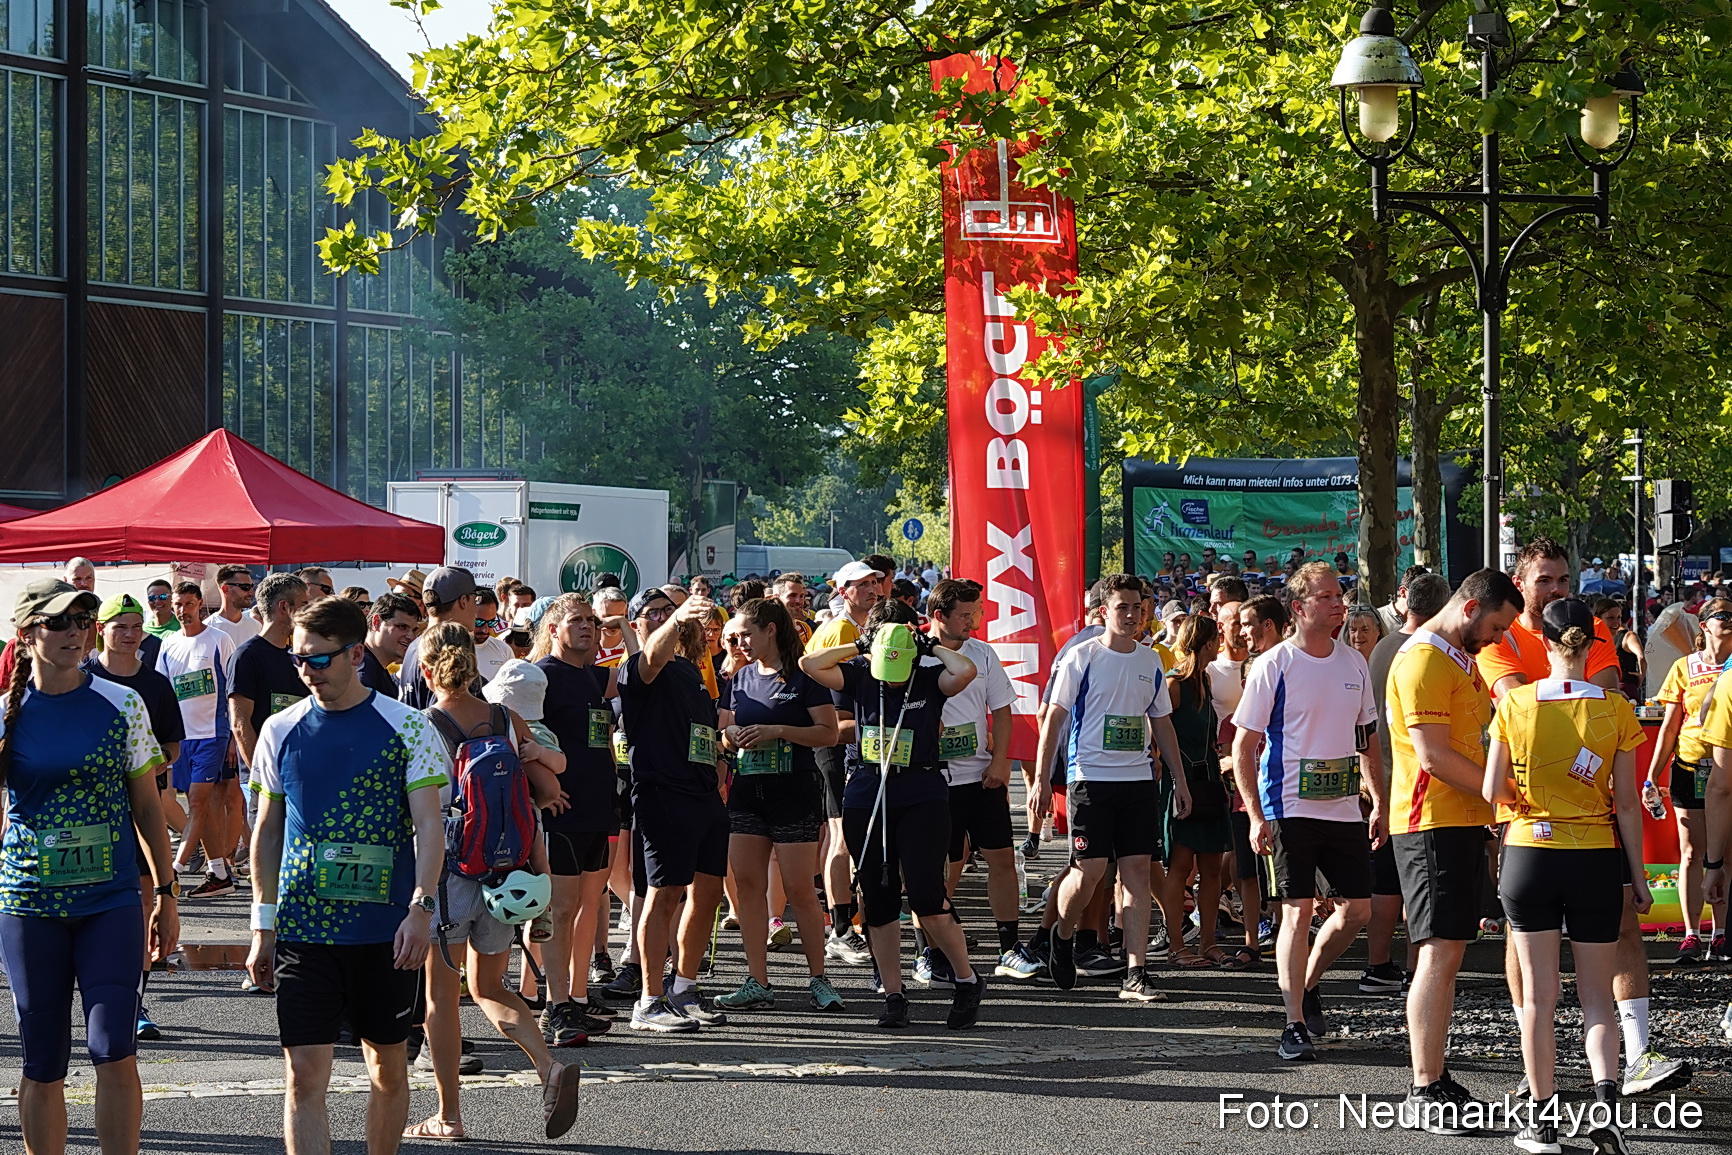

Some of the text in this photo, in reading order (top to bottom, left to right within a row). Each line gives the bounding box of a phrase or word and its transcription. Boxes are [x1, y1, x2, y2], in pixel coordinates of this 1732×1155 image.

[1183, 474, 1203, 486] Mich
[1205, 475, 1226, 487] kann
[1227, 479, 1247, 488] man
[1248, 476, 1281, 488] mieten!
[1282, 476, 1303, 488] Infos
[1305, 477, 1329, 487] unter
[1170, 522, 1235, 540] firmenlauf
[1262, 511, 1340, 539] Gesunde
[460, 526, 500, 543] Bögerl
[454, 559, 488, 569] Metzgerei
[571, 559, 629, 591] Böl
[987, 520, 1040, 716] MAX
[180, 680, 196, 692] 321
[1689, 676, 1714, 688] MAX
[946, 735, 969, 749] 320
[1115, 727, 1138, 740] 313
[744, 750, 766, 763] 721
[1313, 772, 1339, 787] 319
[56, 845, 95, 867] 711
[103, 846, 111, 873] 2022
[42, 855, 51, 876] RUN
[335, 861, 375, 883] 712
[319, 867, 328, 888] RUN
[380, 868, 390, 895] 2022
[351, 882, 378, 892] Michael
